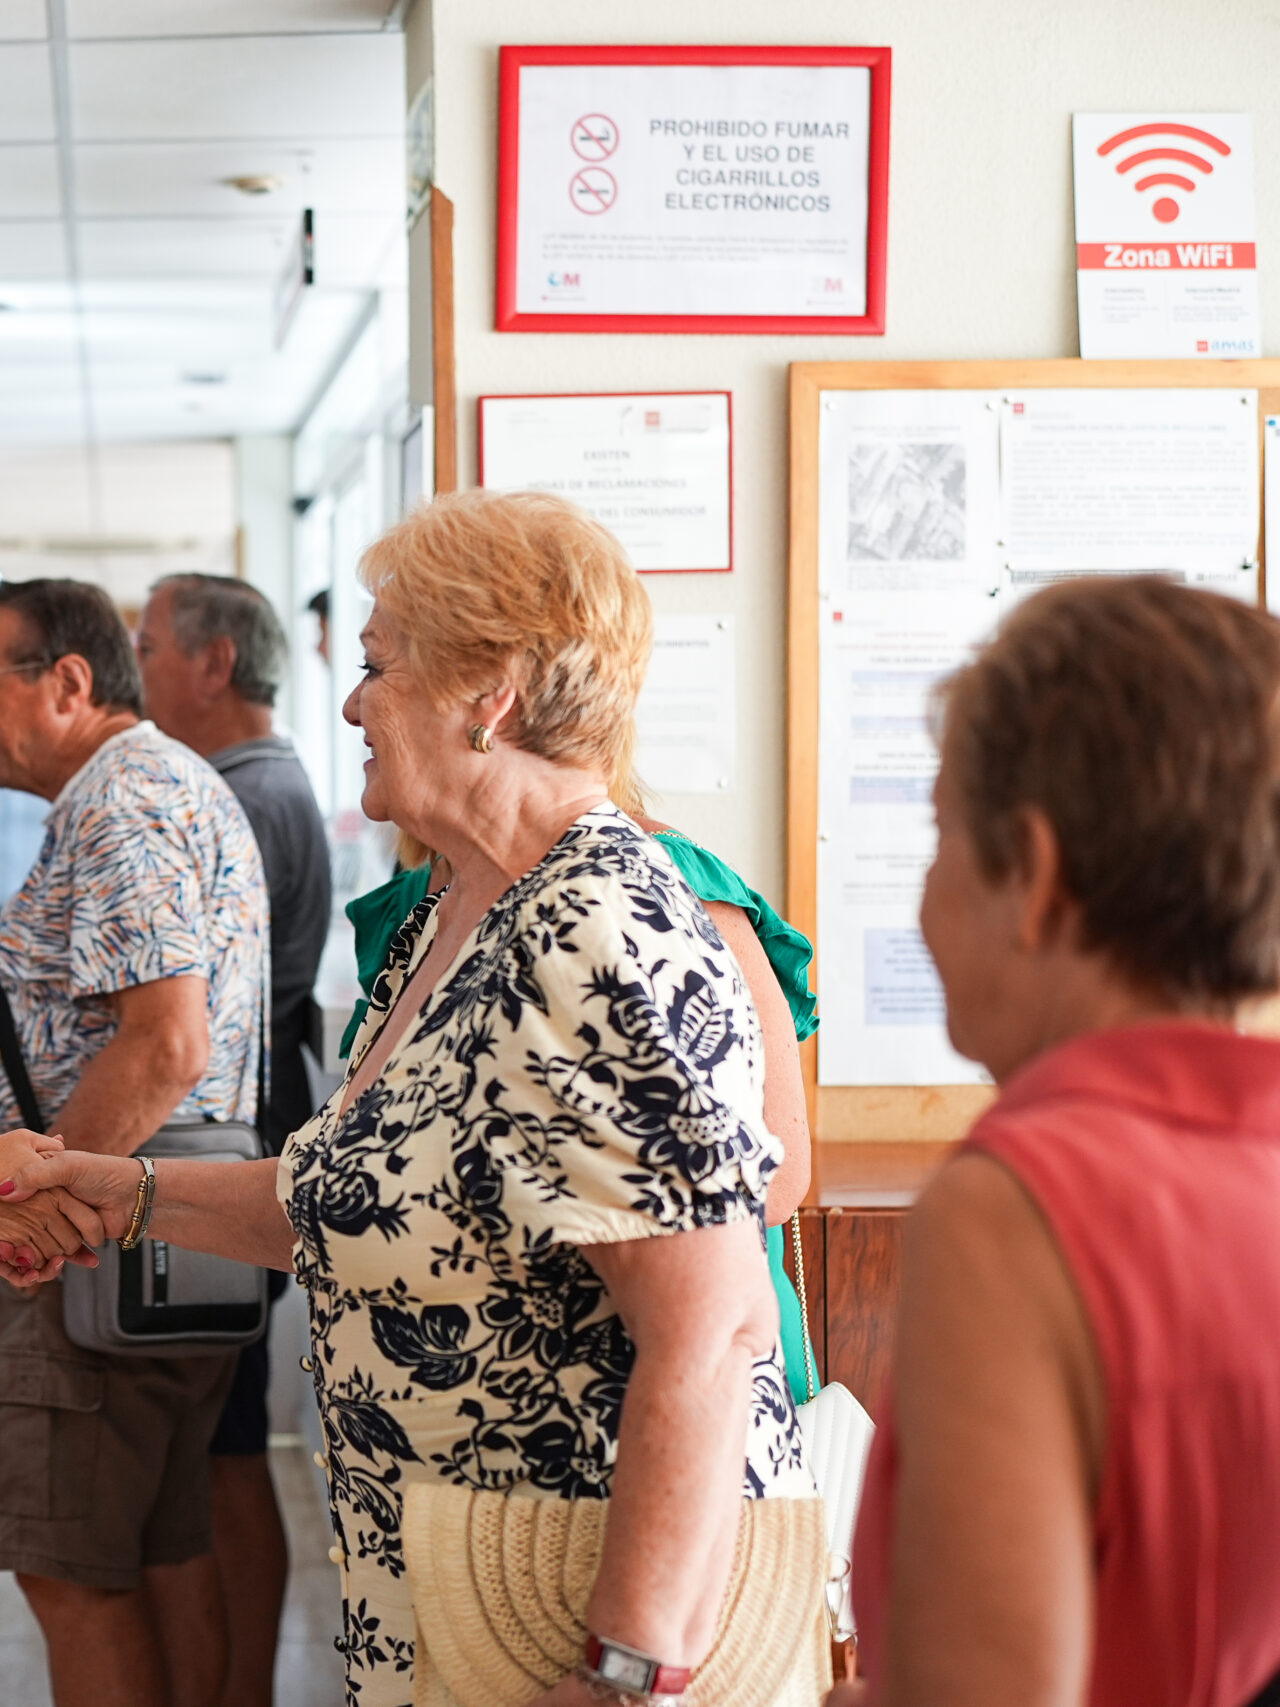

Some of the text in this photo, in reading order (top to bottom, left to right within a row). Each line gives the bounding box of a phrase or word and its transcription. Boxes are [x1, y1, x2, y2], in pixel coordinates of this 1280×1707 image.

[649, 119, 850, 139] PROHIBIDO FUMAR
[683, 144, 815, 163] Y EL USO DE
[675, 168, 821, 188] CIGARRILLOS
[664, 191, 831, 213] ELECTRÓNICOS
[1104, 245, 1234, 268] Zona WiFi
[1211, 338, 1255, 353] amas
